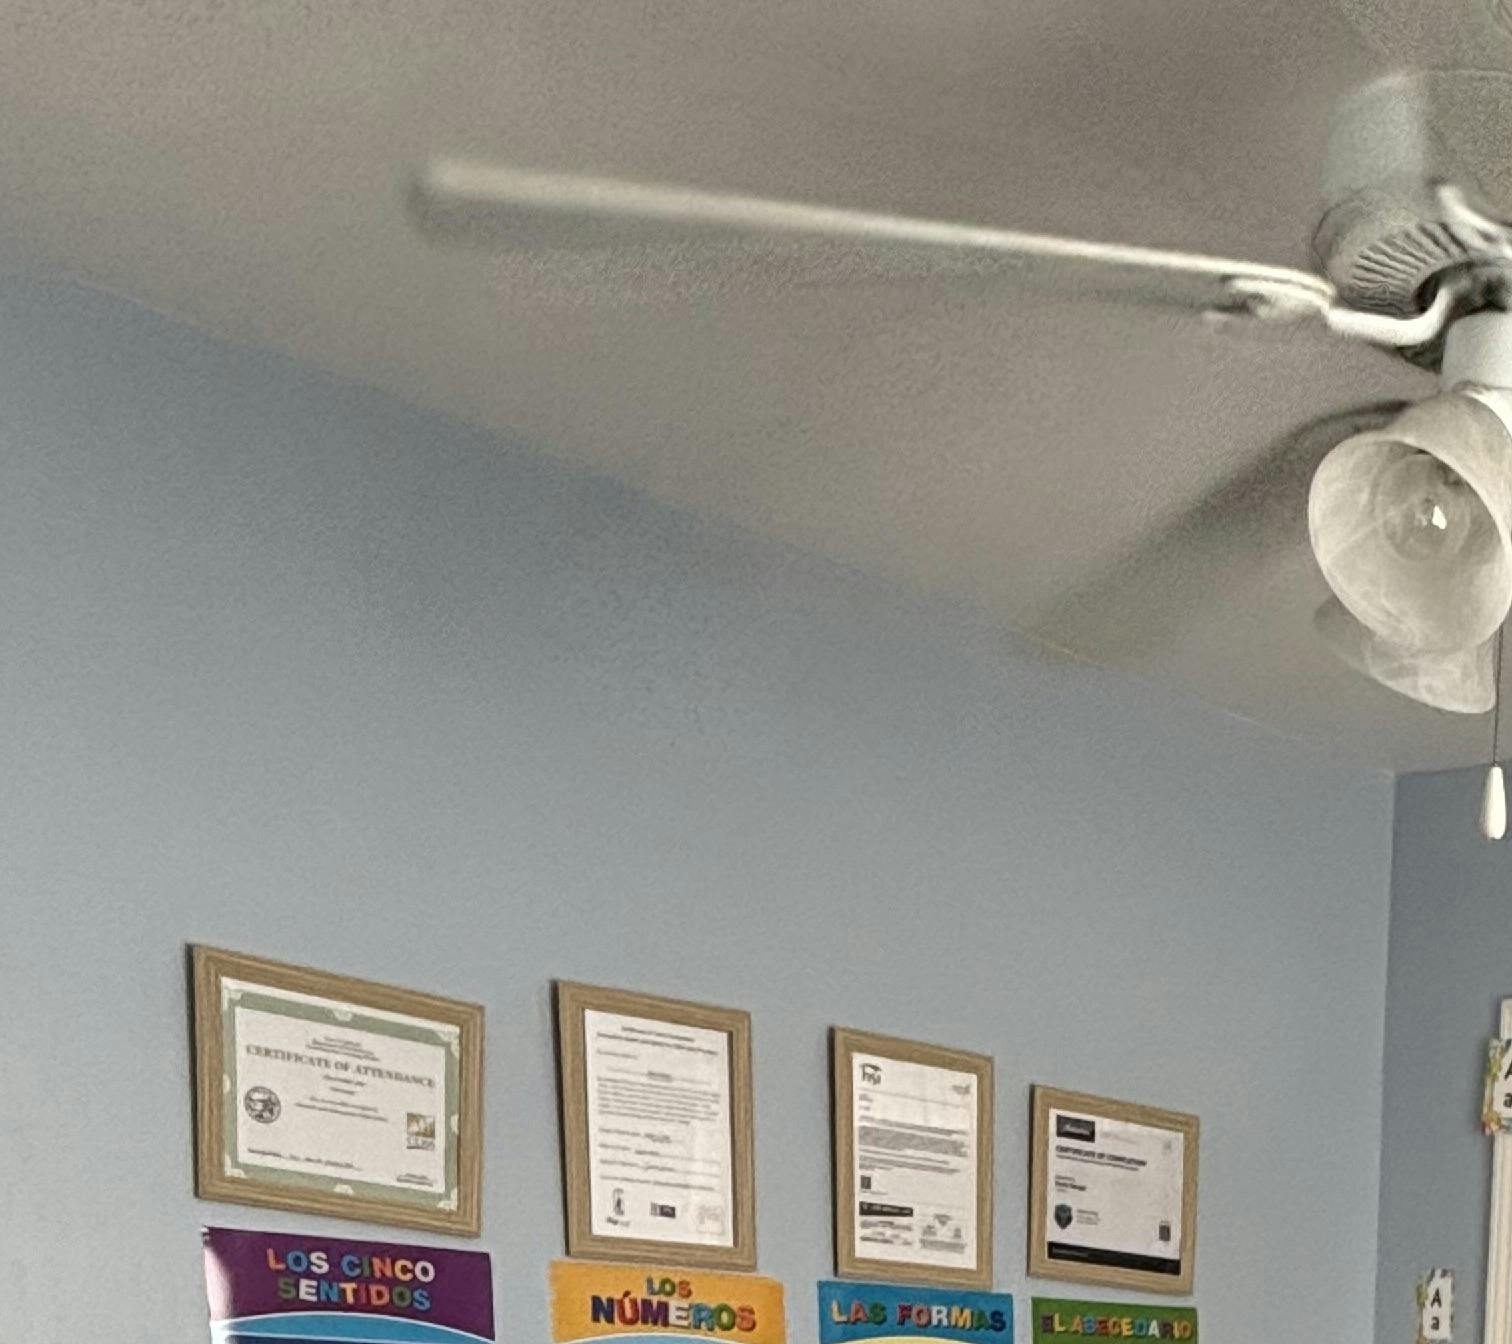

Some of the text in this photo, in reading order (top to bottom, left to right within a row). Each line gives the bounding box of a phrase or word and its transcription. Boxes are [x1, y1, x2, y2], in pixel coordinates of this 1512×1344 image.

[266, 1248, 436, 1283] LOS CINCO
[278, 1277, 432, 1311] SENTIDOS
[647, 1277, 692, 1299] LOS
[590, 1291, 756, 1332] NÚMEROS
[831, 1300, 1007, 1332] LAS FORMAS
